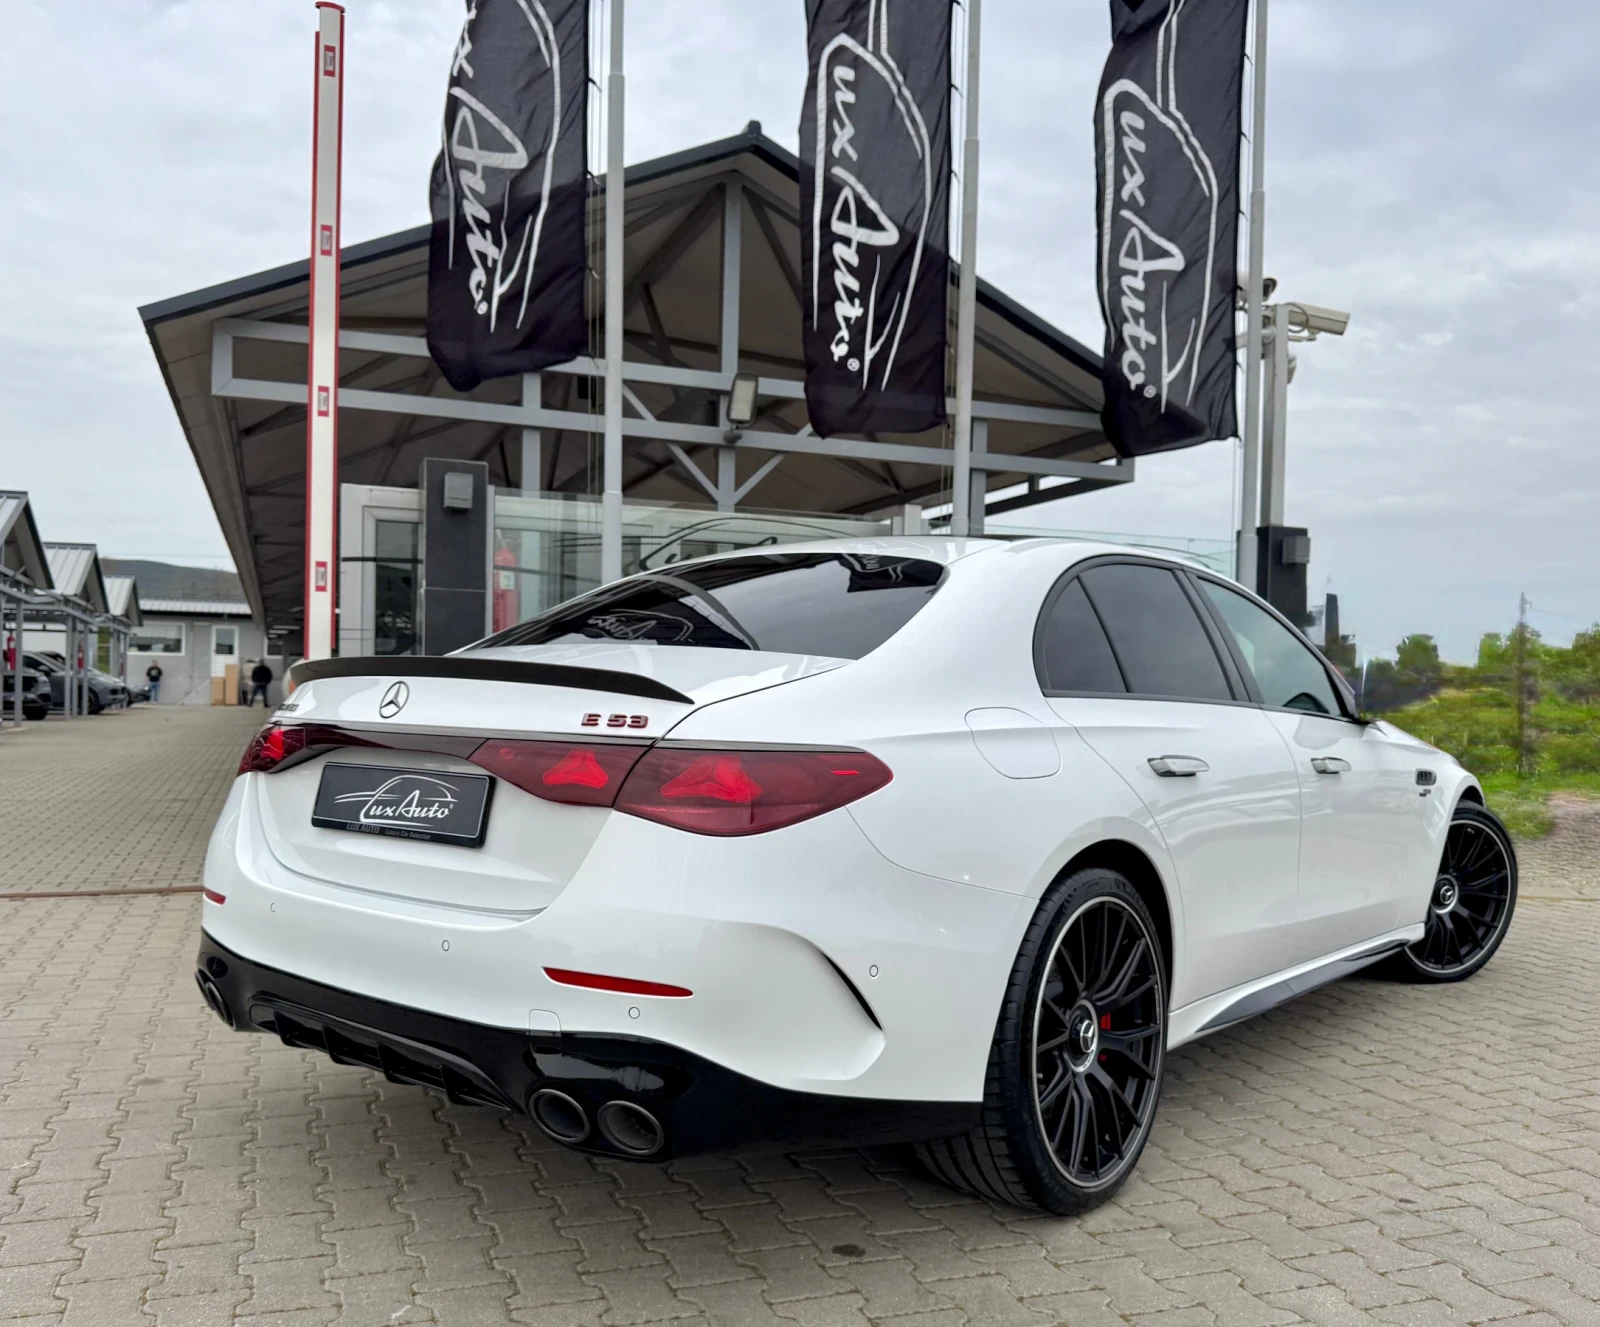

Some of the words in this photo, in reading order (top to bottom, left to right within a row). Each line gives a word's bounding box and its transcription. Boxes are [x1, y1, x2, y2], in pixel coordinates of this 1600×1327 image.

[581, 713, 602, 727] E
[607, 714, 649, 729] 53
[346, 822, 360, 831] LUX
[360, 824, 380, 834] AUTO
